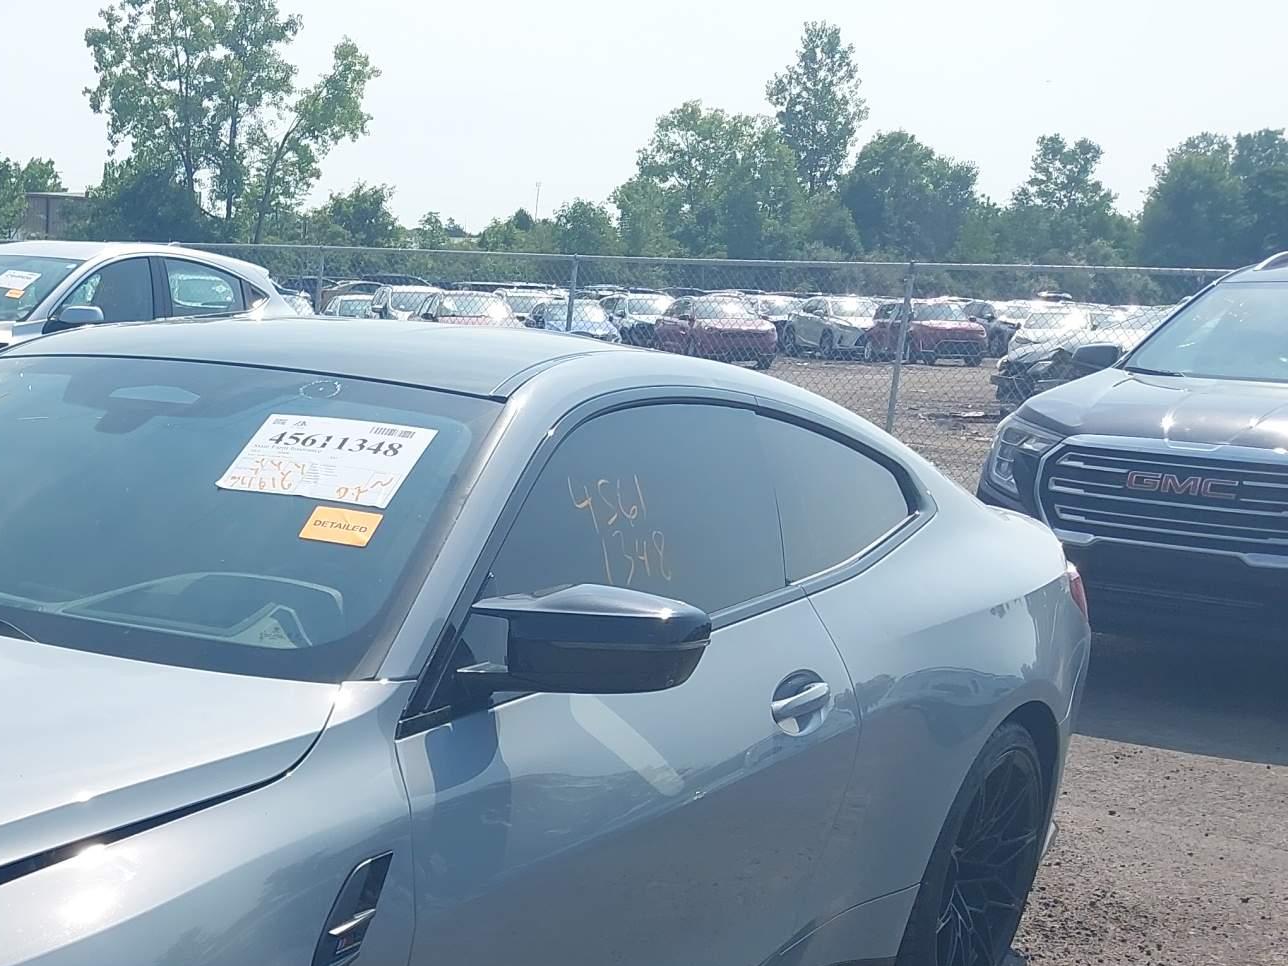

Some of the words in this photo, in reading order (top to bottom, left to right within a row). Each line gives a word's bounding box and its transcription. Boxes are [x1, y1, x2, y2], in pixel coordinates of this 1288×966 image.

[269, 431, 403, 457] 45611348
[1126, 470, 1239, 500] GMC
[567, 474, 648, 534] 4561
[313, 519, 368, 533] DETAILED
